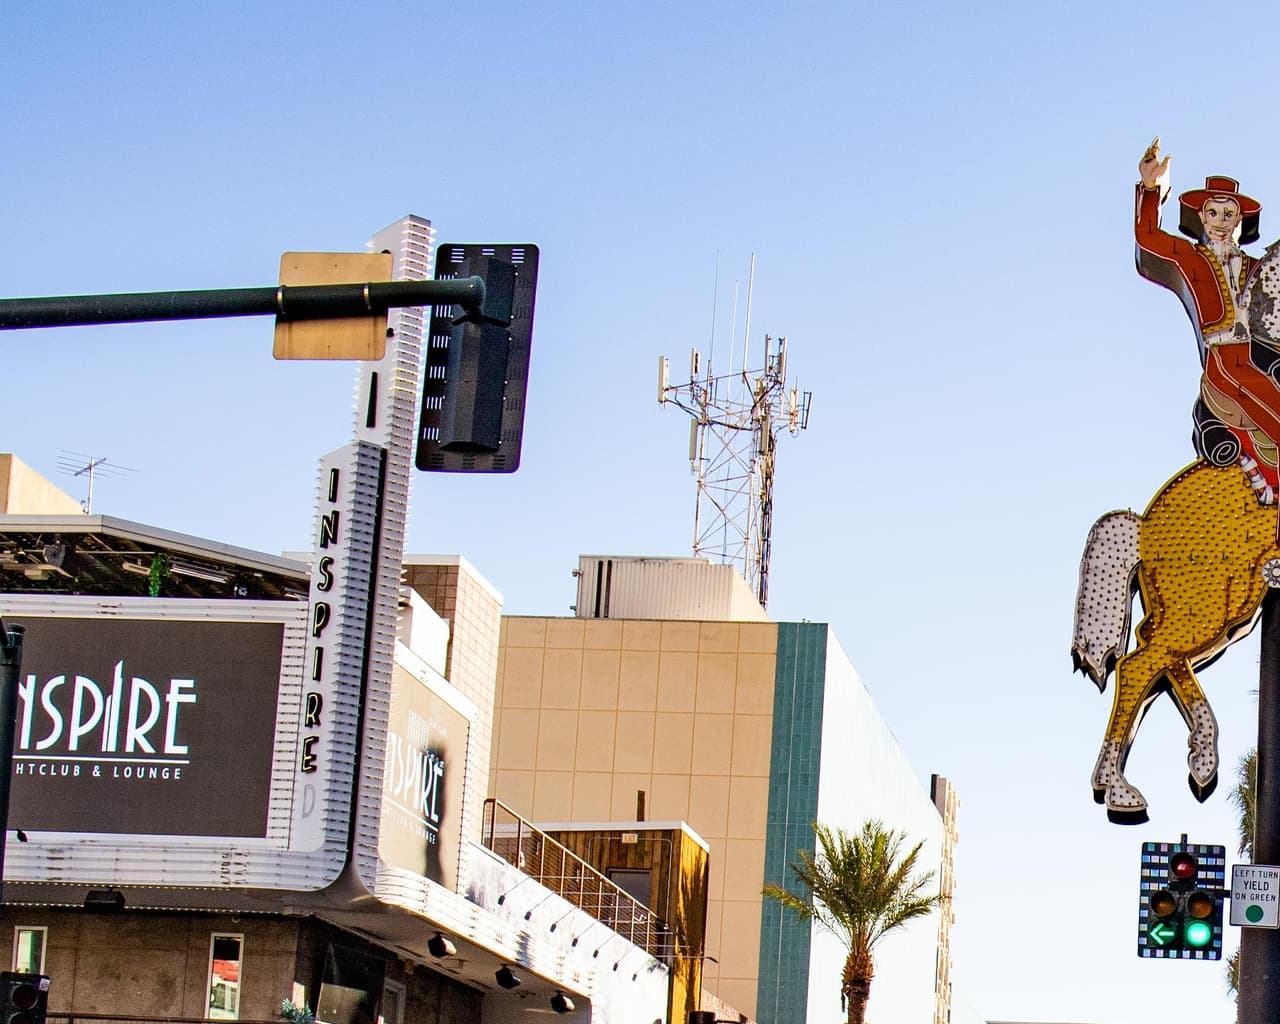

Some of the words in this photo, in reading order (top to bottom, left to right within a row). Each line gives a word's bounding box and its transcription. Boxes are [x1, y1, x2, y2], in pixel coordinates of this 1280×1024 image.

[18, 660, 197, 755] NSPIRE
[16, 763, 81, 776] HTCLUB
[92, 764, 101, 777] &
[113, 766, 182, 780] LOUNGE
[1235, 869, 1255, 878] LEFT
[1259, 870, 1279, 879] TURN
[1243, 880, 1270, 891] YIELD
[1235, 892, 1246, 900] ON
[1250, 893, 1276, 902] GREEN
